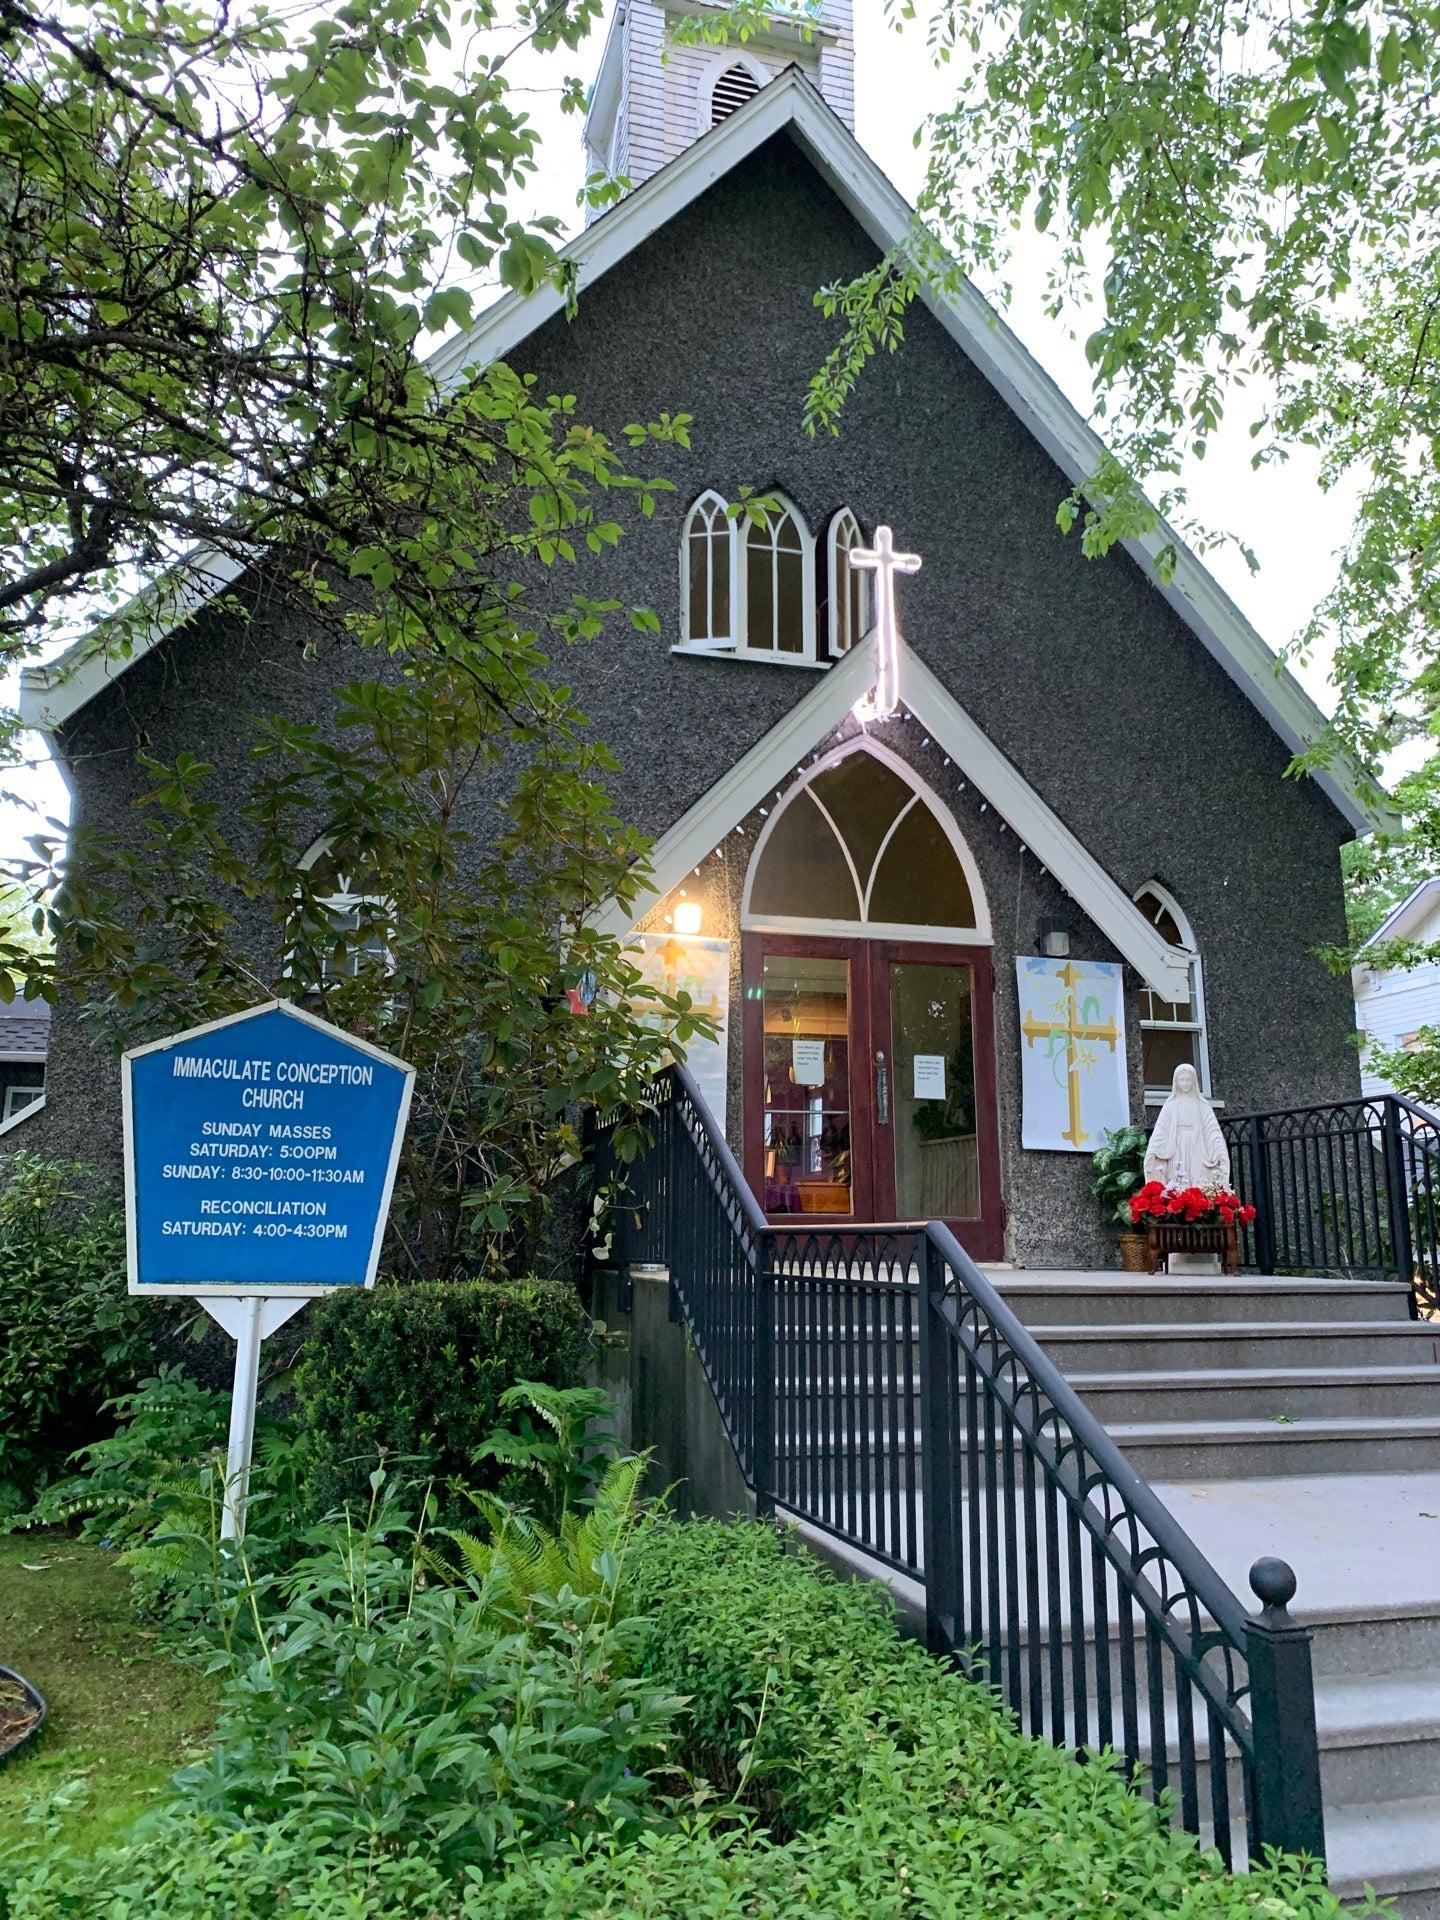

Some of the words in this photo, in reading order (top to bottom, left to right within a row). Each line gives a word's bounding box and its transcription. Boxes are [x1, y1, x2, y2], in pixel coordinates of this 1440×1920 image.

[174, 1057, 271, 1080] IMMACULATE
[277, 1062, 372, 1085] CONCEPTION
[243, 1088, 303, 1109] CHURCH
[202, 1122, 261, 1136] SUNDAY
[270, 1125, 331, 1139] MASSES
[190, 1143, 272, 1157] SATURDAY:
[280, 1146, 336, 1159] 5:00PM
[163, 1165, 224, 1178] SUNDAY:
[232, 1167, 364, 1183] 8:30-10:00-11:30AM
[201, 1200, 326, 1215] RECONCILIATION
[162, 1222, 245, 1235] SATURDAY:
[253, 1224, 347, 1237] 4:00-4:30PM
